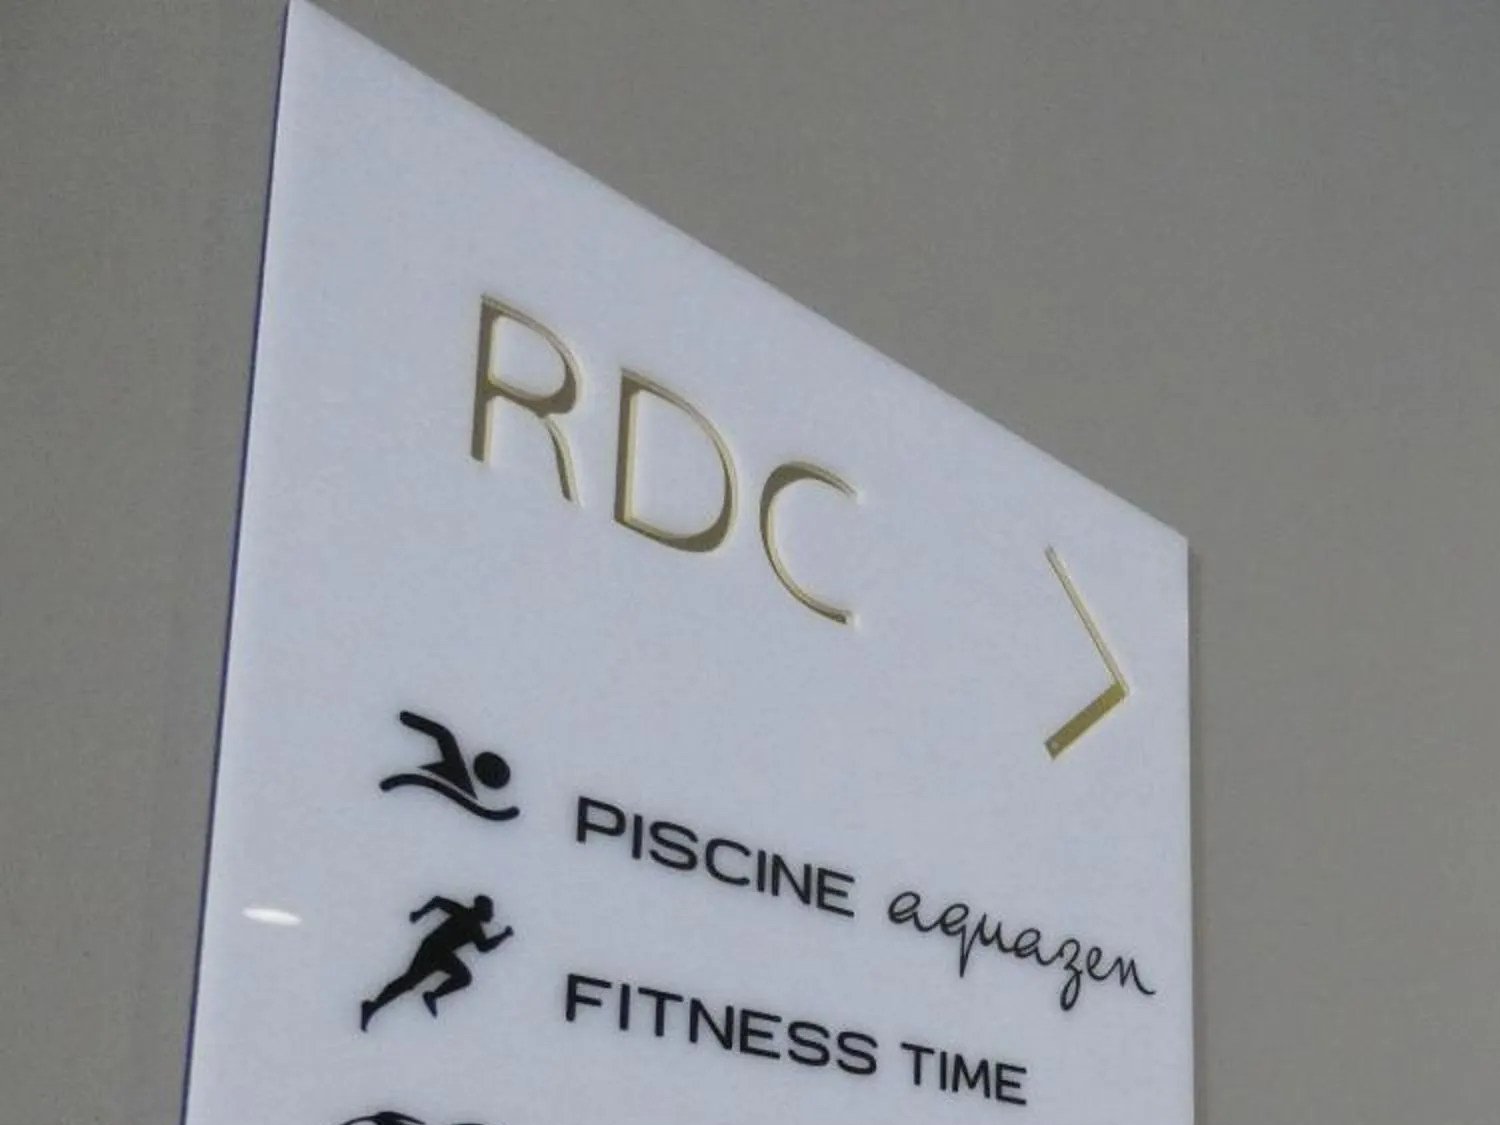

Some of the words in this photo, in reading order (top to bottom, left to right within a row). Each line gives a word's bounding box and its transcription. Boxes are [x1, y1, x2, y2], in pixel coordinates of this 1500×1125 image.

[471, 294, 864, 628] RDC
[575, 795, 856, 919] PISCINE
[886, 889, 1157, 1011] aquazen
[564, 972, 879, 1077] FITNESS
[899, 1041, 1028, 1107] TIME
